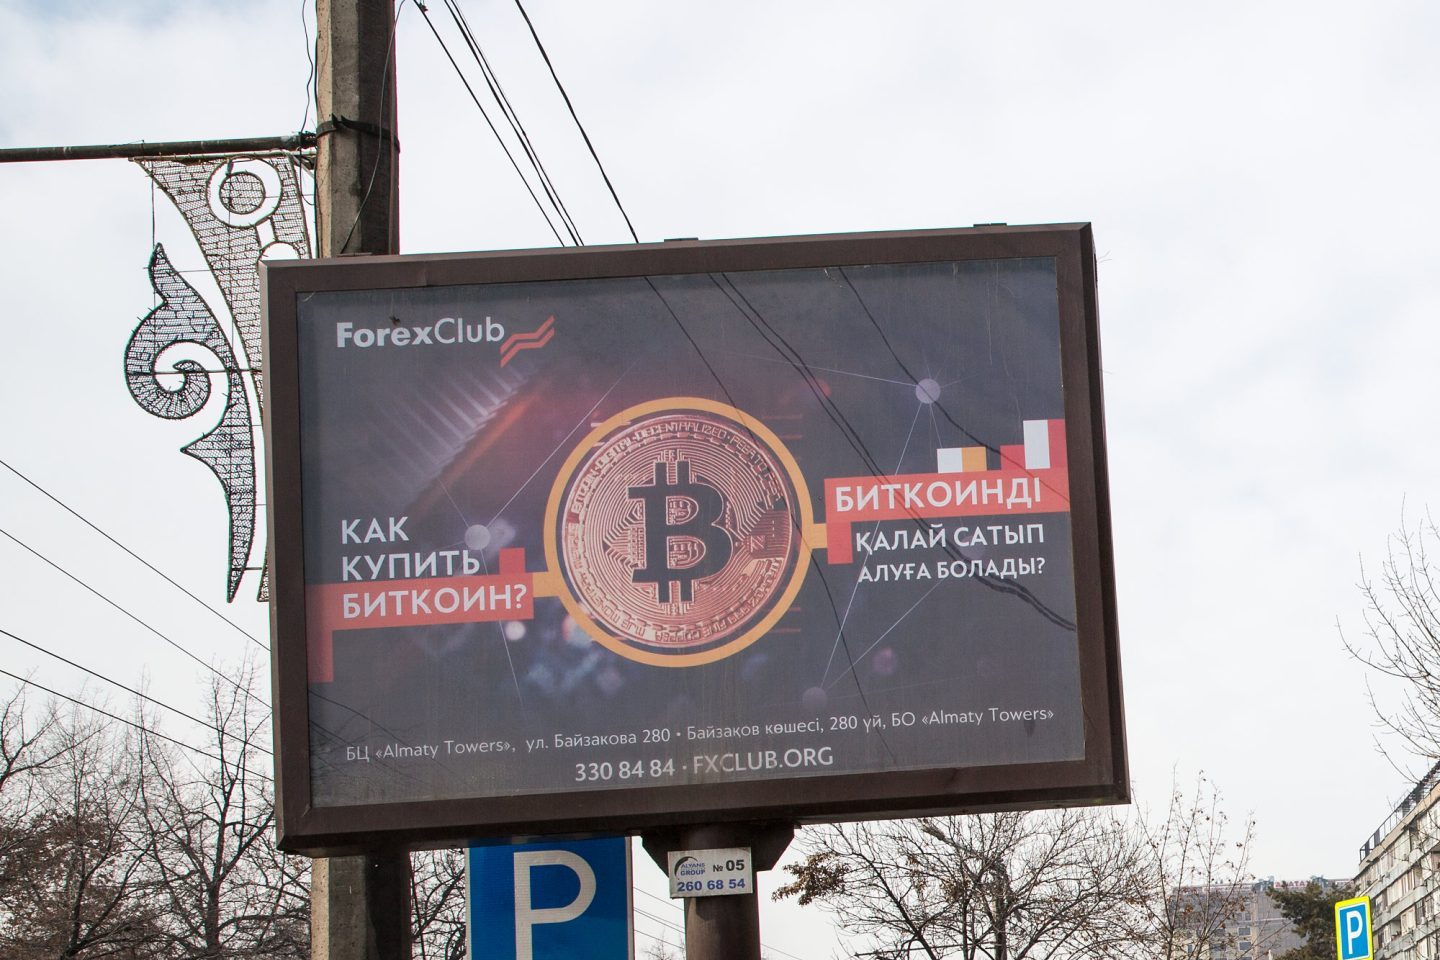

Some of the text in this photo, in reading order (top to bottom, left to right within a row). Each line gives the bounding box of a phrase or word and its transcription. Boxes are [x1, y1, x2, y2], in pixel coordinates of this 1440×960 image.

[336, 316, 505, 348] ForexClub
[634, 421, 726, 440] DECENTRALIZED
[835, 477, 1041, 512] БИТКОИНДІ
[341, 516, 410, 545] КАК
[855, 523, 1044, 556] ҚАЛАЙ САТЫП
[342, 550, 480, 582] КУПИТЬ
[858, 557, 1046, 583] АЛУҒА БОЛАДЫ?
[343, 583, 527, 619] БИТКОИН?
[687, 724, 760, 742] Байзақов
[829, 715, 858, 731] 280
[891, 711, 916, 727] БО
[921, 709, 983, 726] «Almaty
[988, 706, 1055, 723] Towers»
[346, 728, 671, 763] БЦ «Almaty Towers», ул. Байзакова 280
[693, 746, 834, 774] FXCLUB.ORG
[575, 757, 676, 782] 330 84 84
[680, 869, 706, 877] GROUP
[725, 859, 745, 872] 05
[677, 878, 745, 892] 260 68 54
